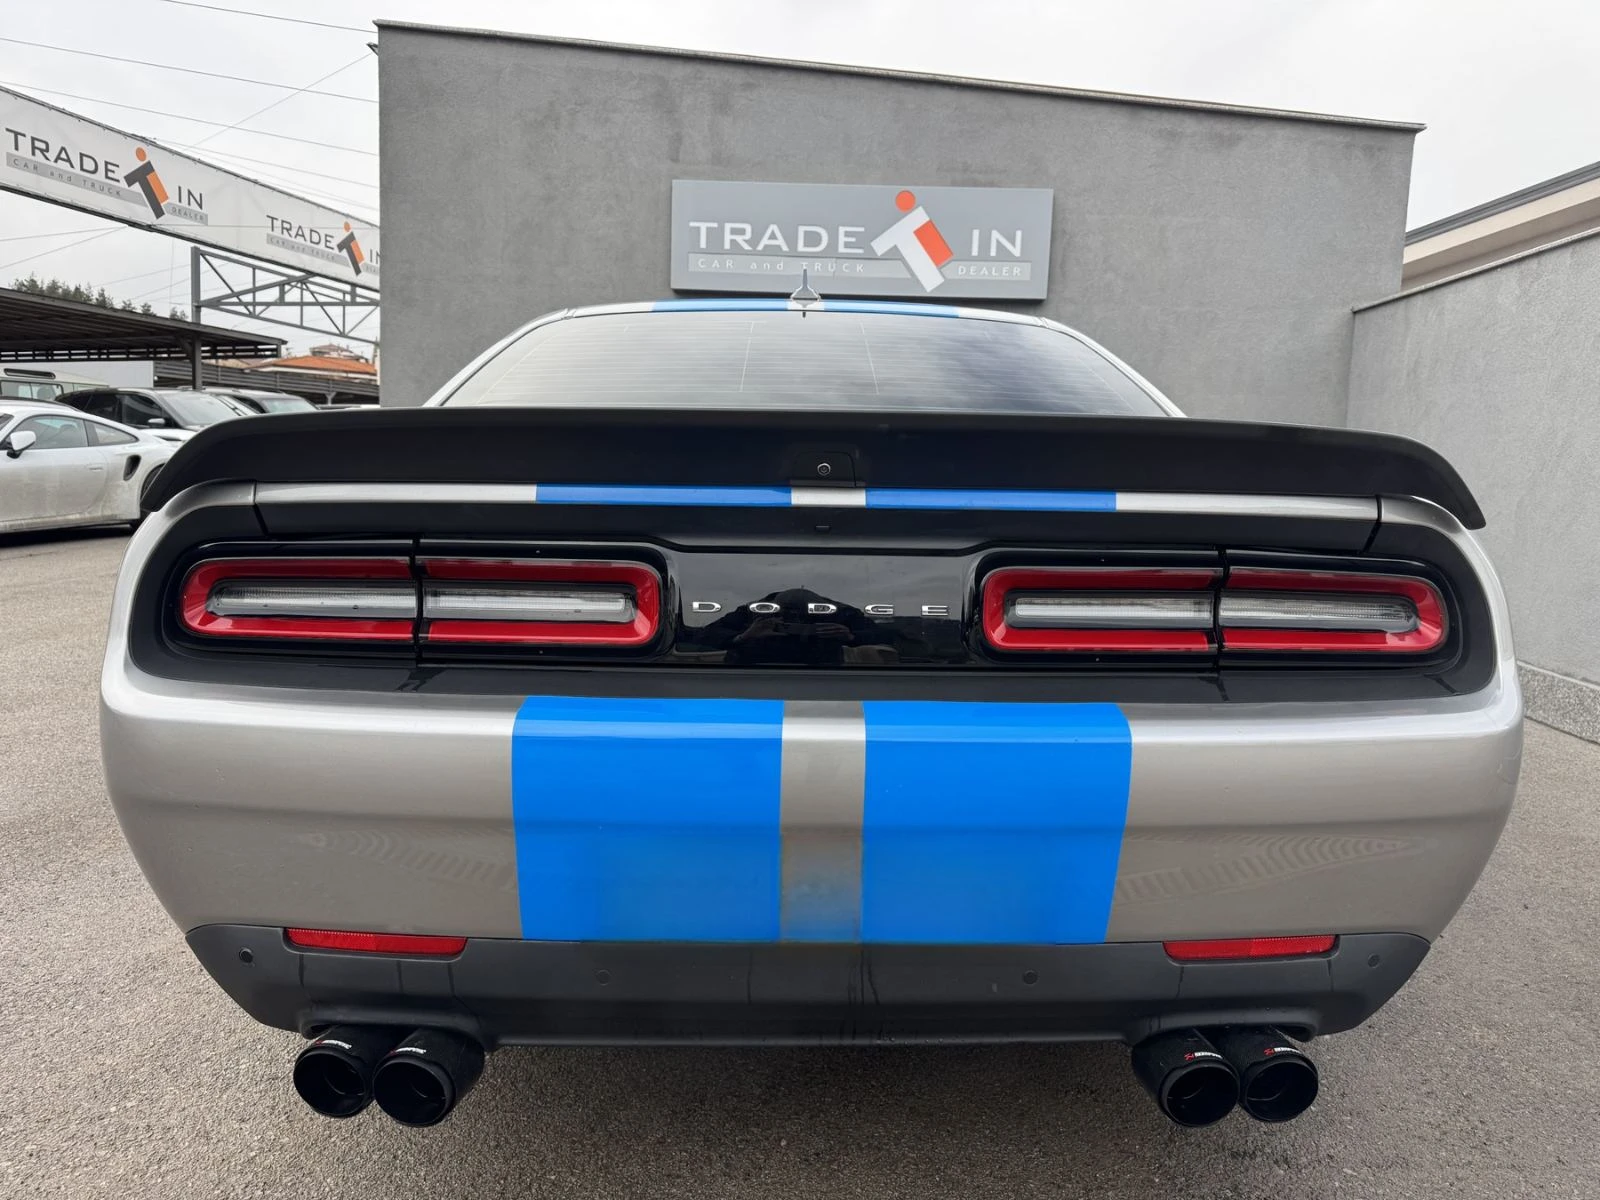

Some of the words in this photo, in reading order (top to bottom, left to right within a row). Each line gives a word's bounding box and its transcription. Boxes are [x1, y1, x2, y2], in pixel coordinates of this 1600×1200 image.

[5, 127, 120, 182] TRADE
[177, 185, 203, 210] IN
[13, 158, 39, 173] CAR
[50, 169, 72, 182] and
[82, 179, 121, 196] TRUCK
[266, 214, 335, 250] TRADE
[689, 221, 865, 254] TRADE
[971, 229, 1022, 257] IN
[698, 258, 734, 269] CAR
[750, 259, 784, 271] and
[801, 262, 865, 273] TRUCK
[958, 265, 1022, 277] DEALER
[692, 601, 949, 616] DODGE
